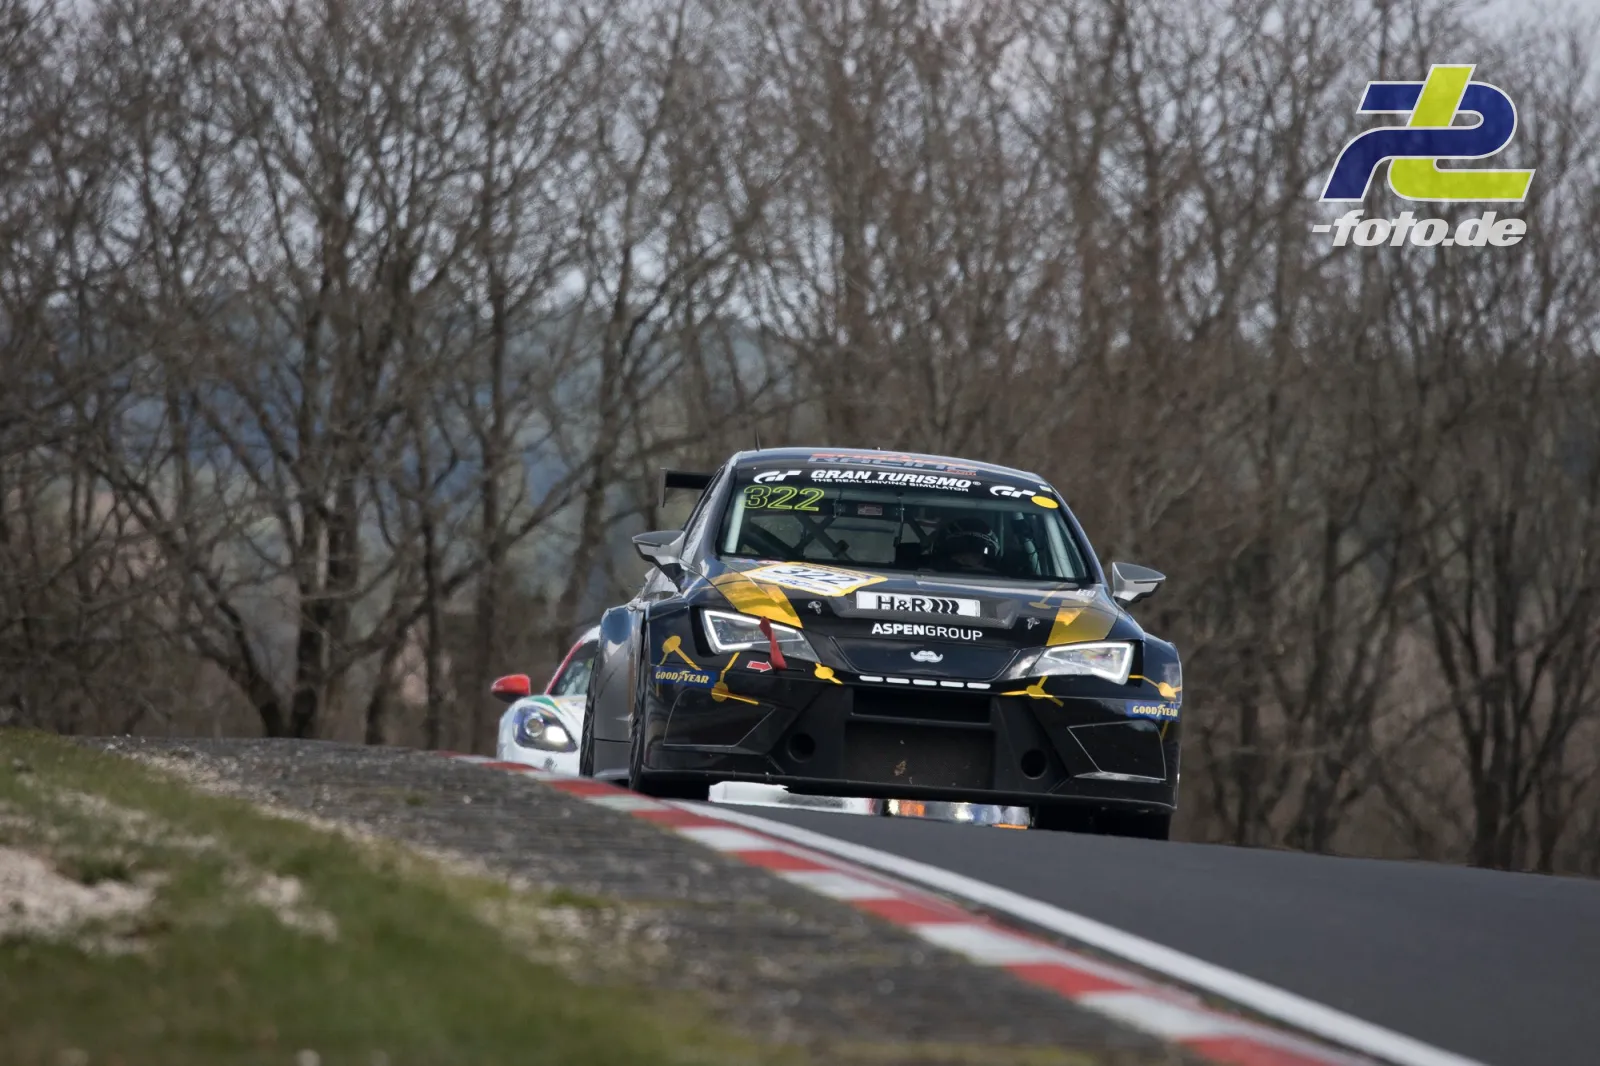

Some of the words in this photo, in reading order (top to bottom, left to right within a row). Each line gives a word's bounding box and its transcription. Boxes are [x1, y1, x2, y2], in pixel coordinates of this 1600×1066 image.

[810, 469, 872, 480] GRAN
[864, 479, 907, 487] DRIVING
[908, 482, 969, 493] SIMULATOR
[743, 484, 825, 512] 322
[655, 670, 710, 684] GOODYEAR
[1132, 704, 1179, 718] GOODYEAR
